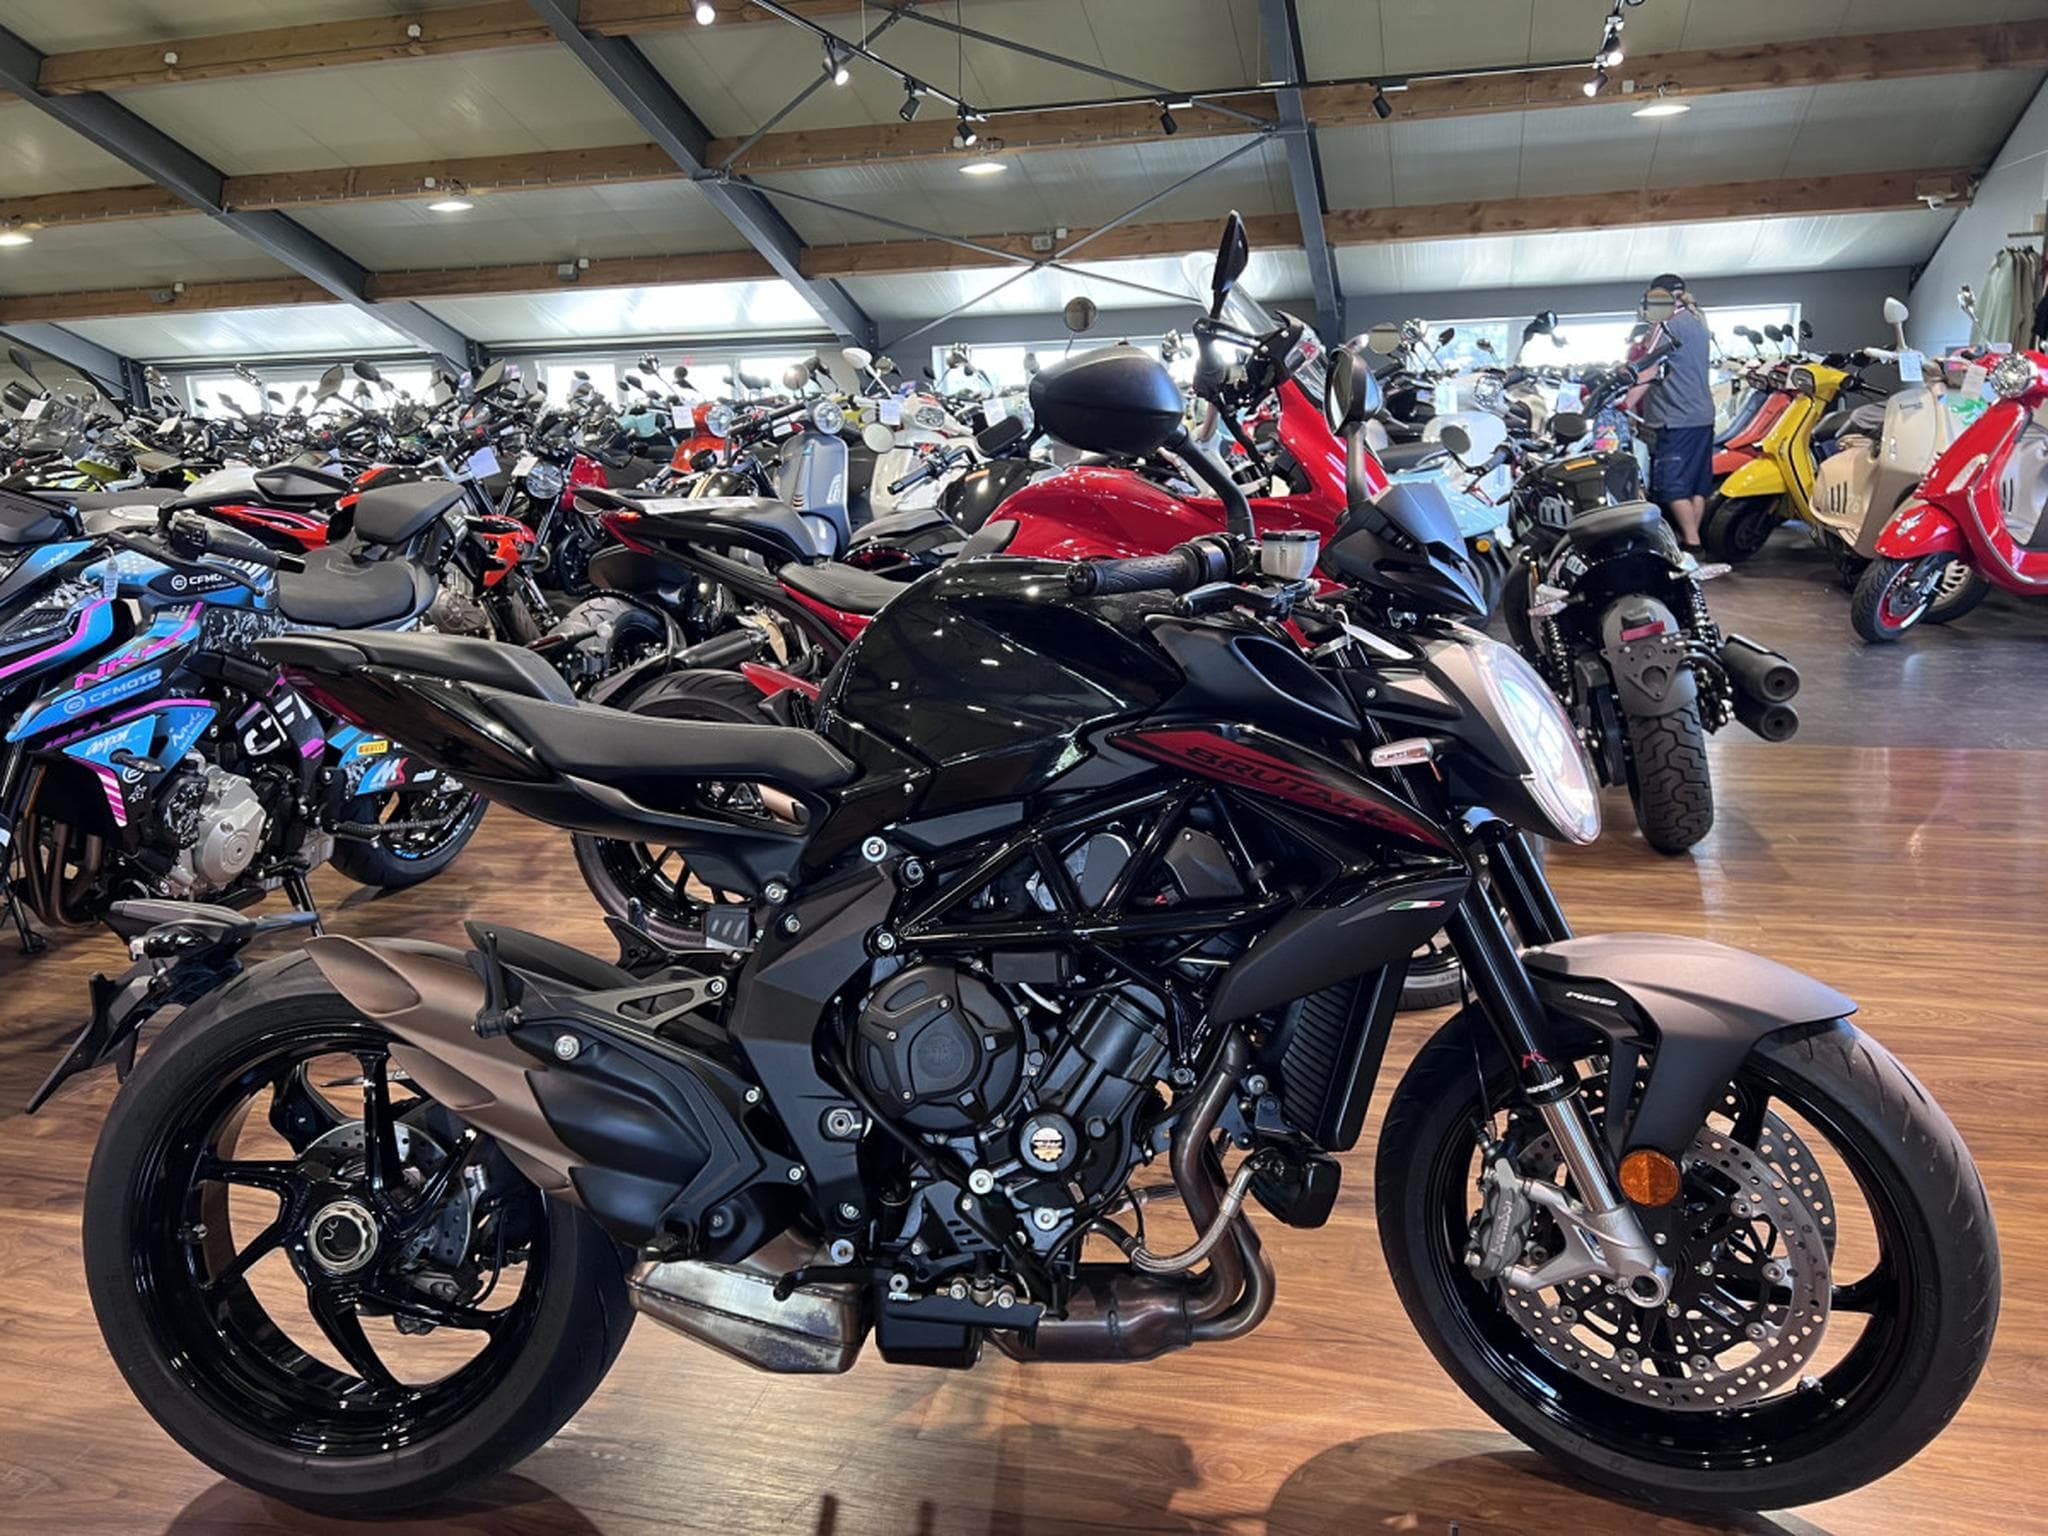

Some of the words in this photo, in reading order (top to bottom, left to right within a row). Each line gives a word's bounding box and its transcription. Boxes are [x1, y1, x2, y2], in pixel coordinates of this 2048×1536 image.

[189, 574, 228, 586] CFMO
[89, 668, 162, 703] CFMOTO
[1185, 746, 1393, 824] BRUTALE
